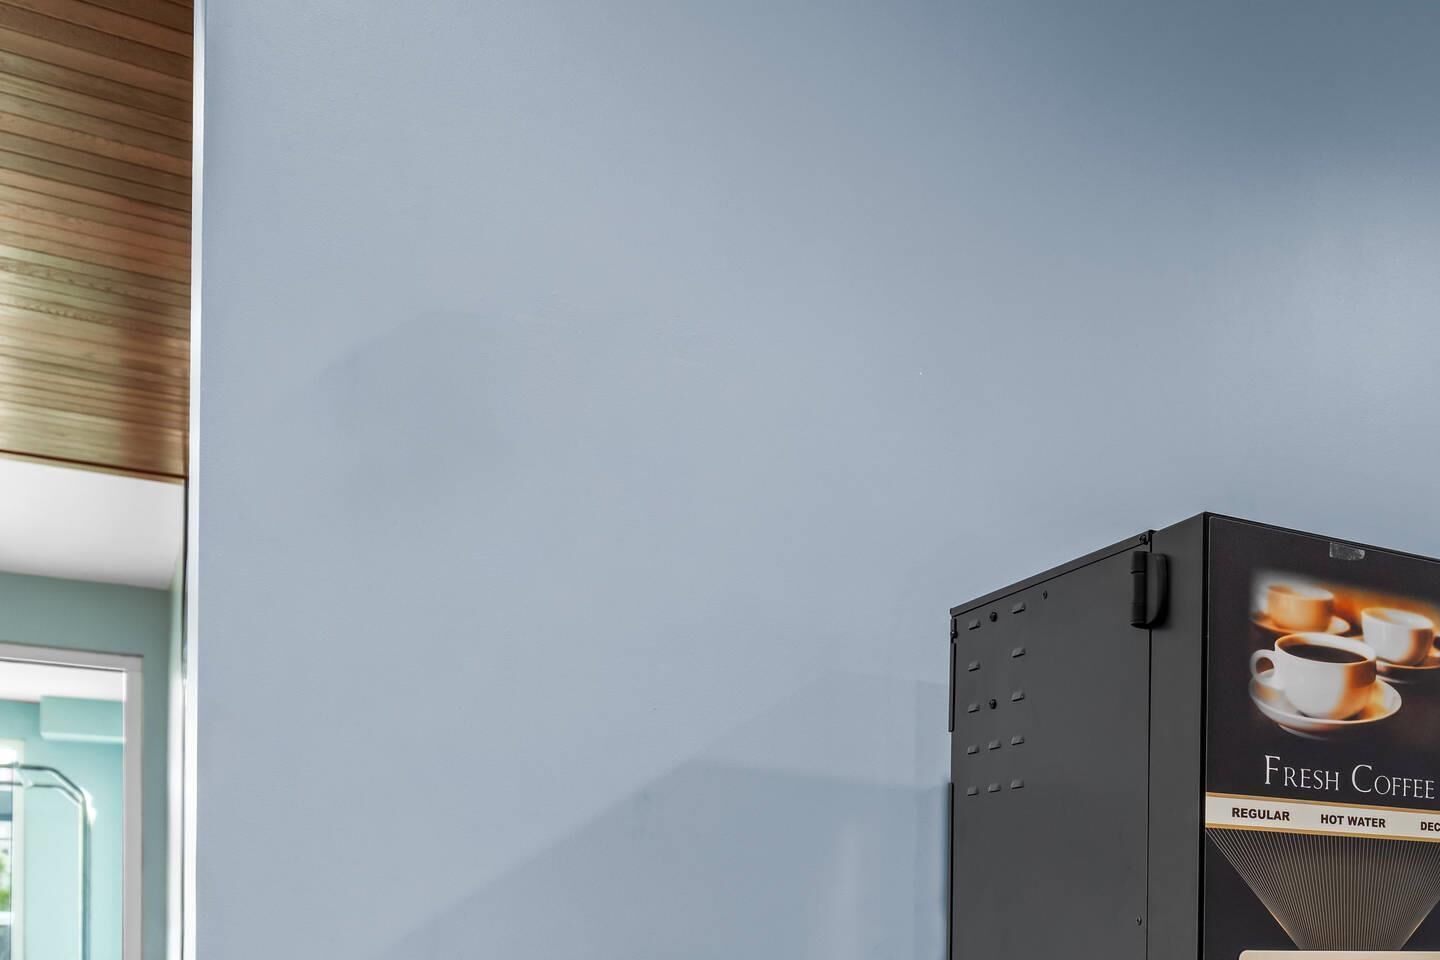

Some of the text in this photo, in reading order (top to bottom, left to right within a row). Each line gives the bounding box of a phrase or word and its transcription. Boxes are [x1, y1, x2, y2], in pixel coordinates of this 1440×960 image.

[1264, 753, 1435, 800] FRESH COFFEE
[1231, 807, 1290, 821] REGULAR
[1320, 814, 1344, 826] HOT
[1347, 816, 1386, 829] WATER
